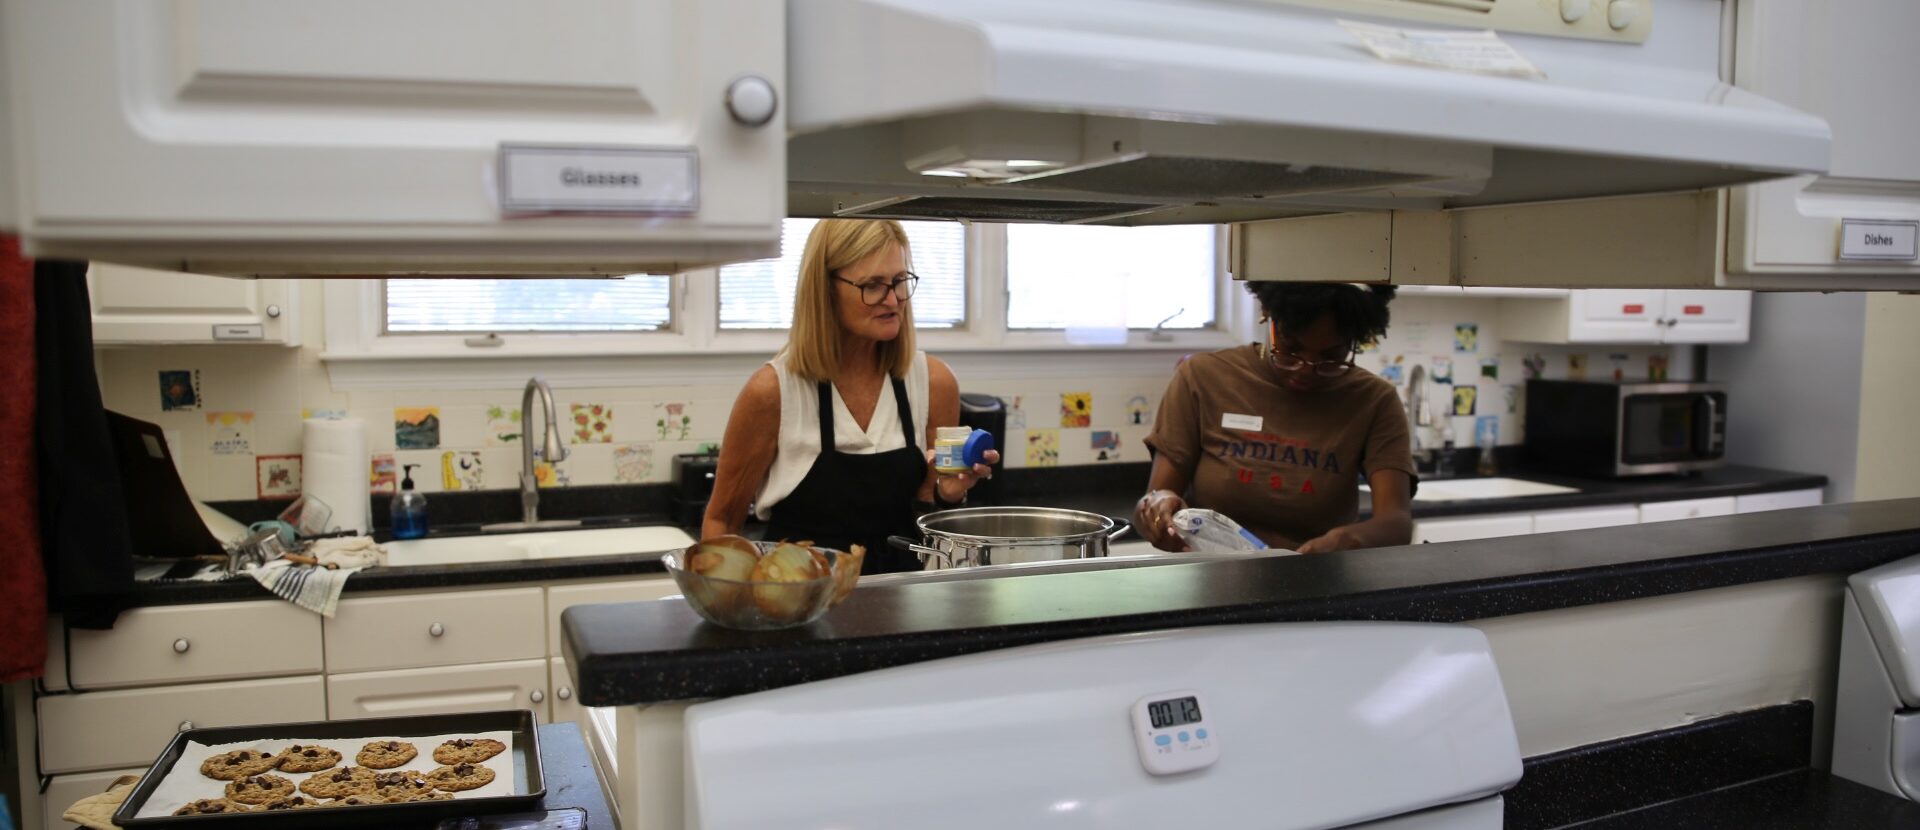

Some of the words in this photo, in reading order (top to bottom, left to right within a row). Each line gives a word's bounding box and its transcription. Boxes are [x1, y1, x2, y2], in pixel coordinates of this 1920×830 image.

[560, 167, 641, 188] Glasses
[1865, 234, 1893, 246] Dishes
[1221, 441, 1339, 473] INDIANA
